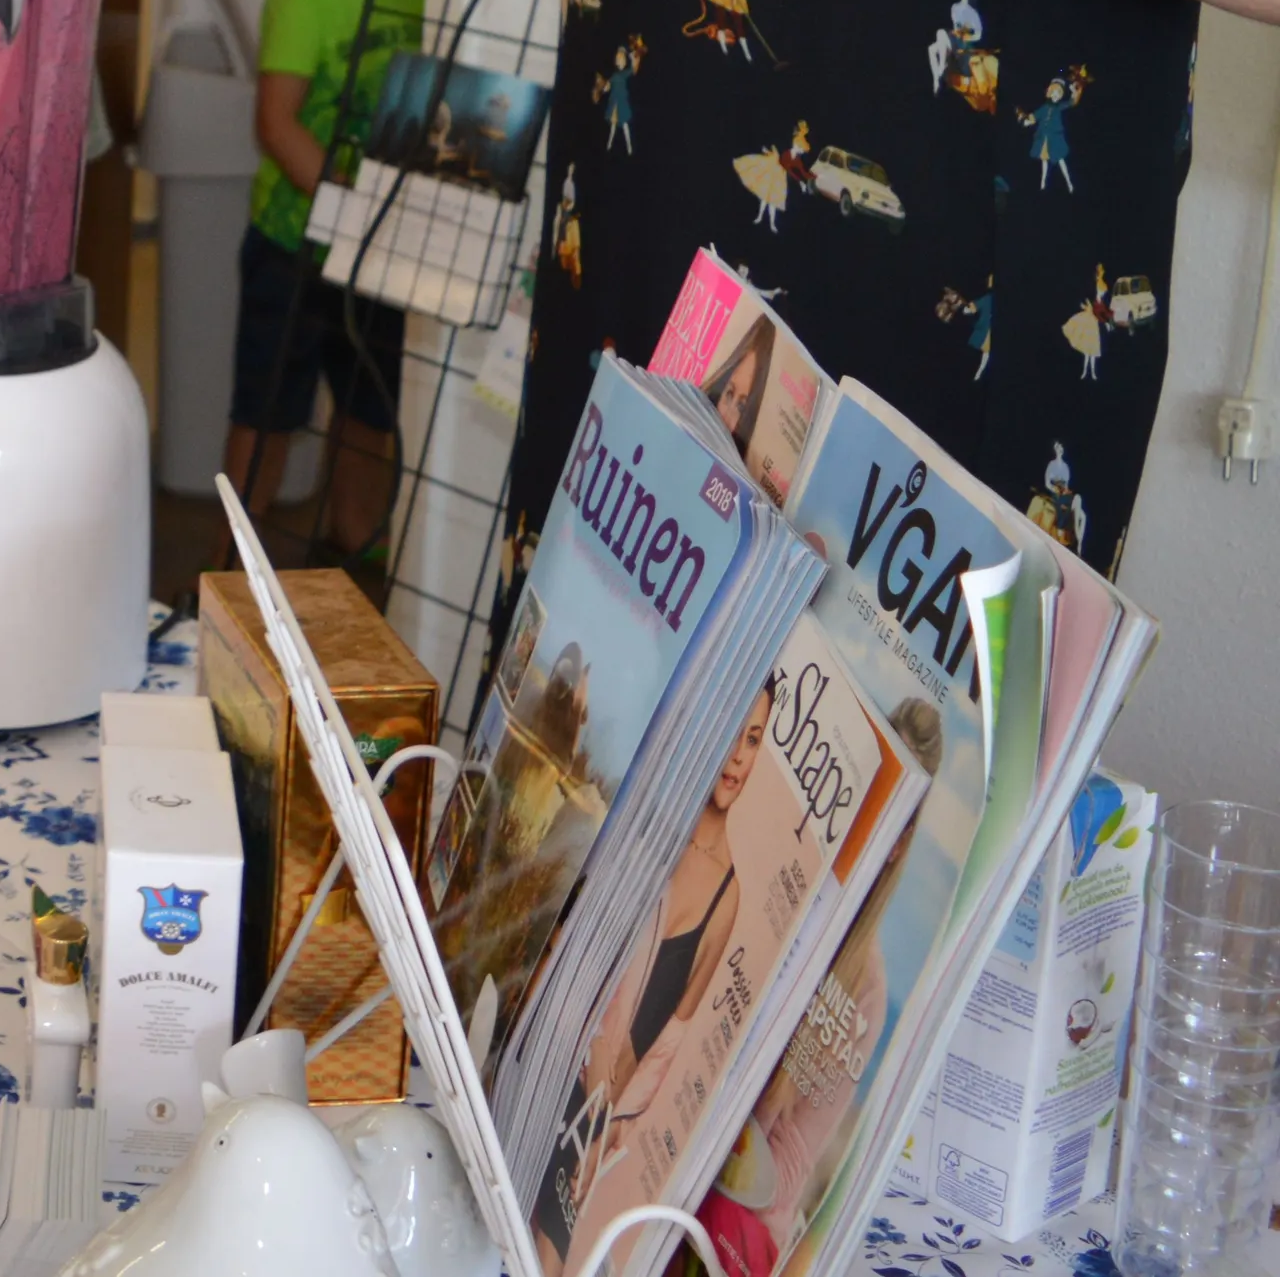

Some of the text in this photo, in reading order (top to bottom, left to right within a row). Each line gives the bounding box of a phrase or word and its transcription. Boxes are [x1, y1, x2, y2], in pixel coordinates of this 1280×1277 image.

[669, 270, 732, 362] BEAU
[562, 401, 706, 633] Ruinen
[704, 476, 734, 512] 2018
[846, 585, 949, 705] LIFESTYLE MAGAZINE
[772, 662, 853, 845] Shape
[118, 971, 219, 994] DOLCE AMALFI
[727, 947, 753, 1008] Dossier
